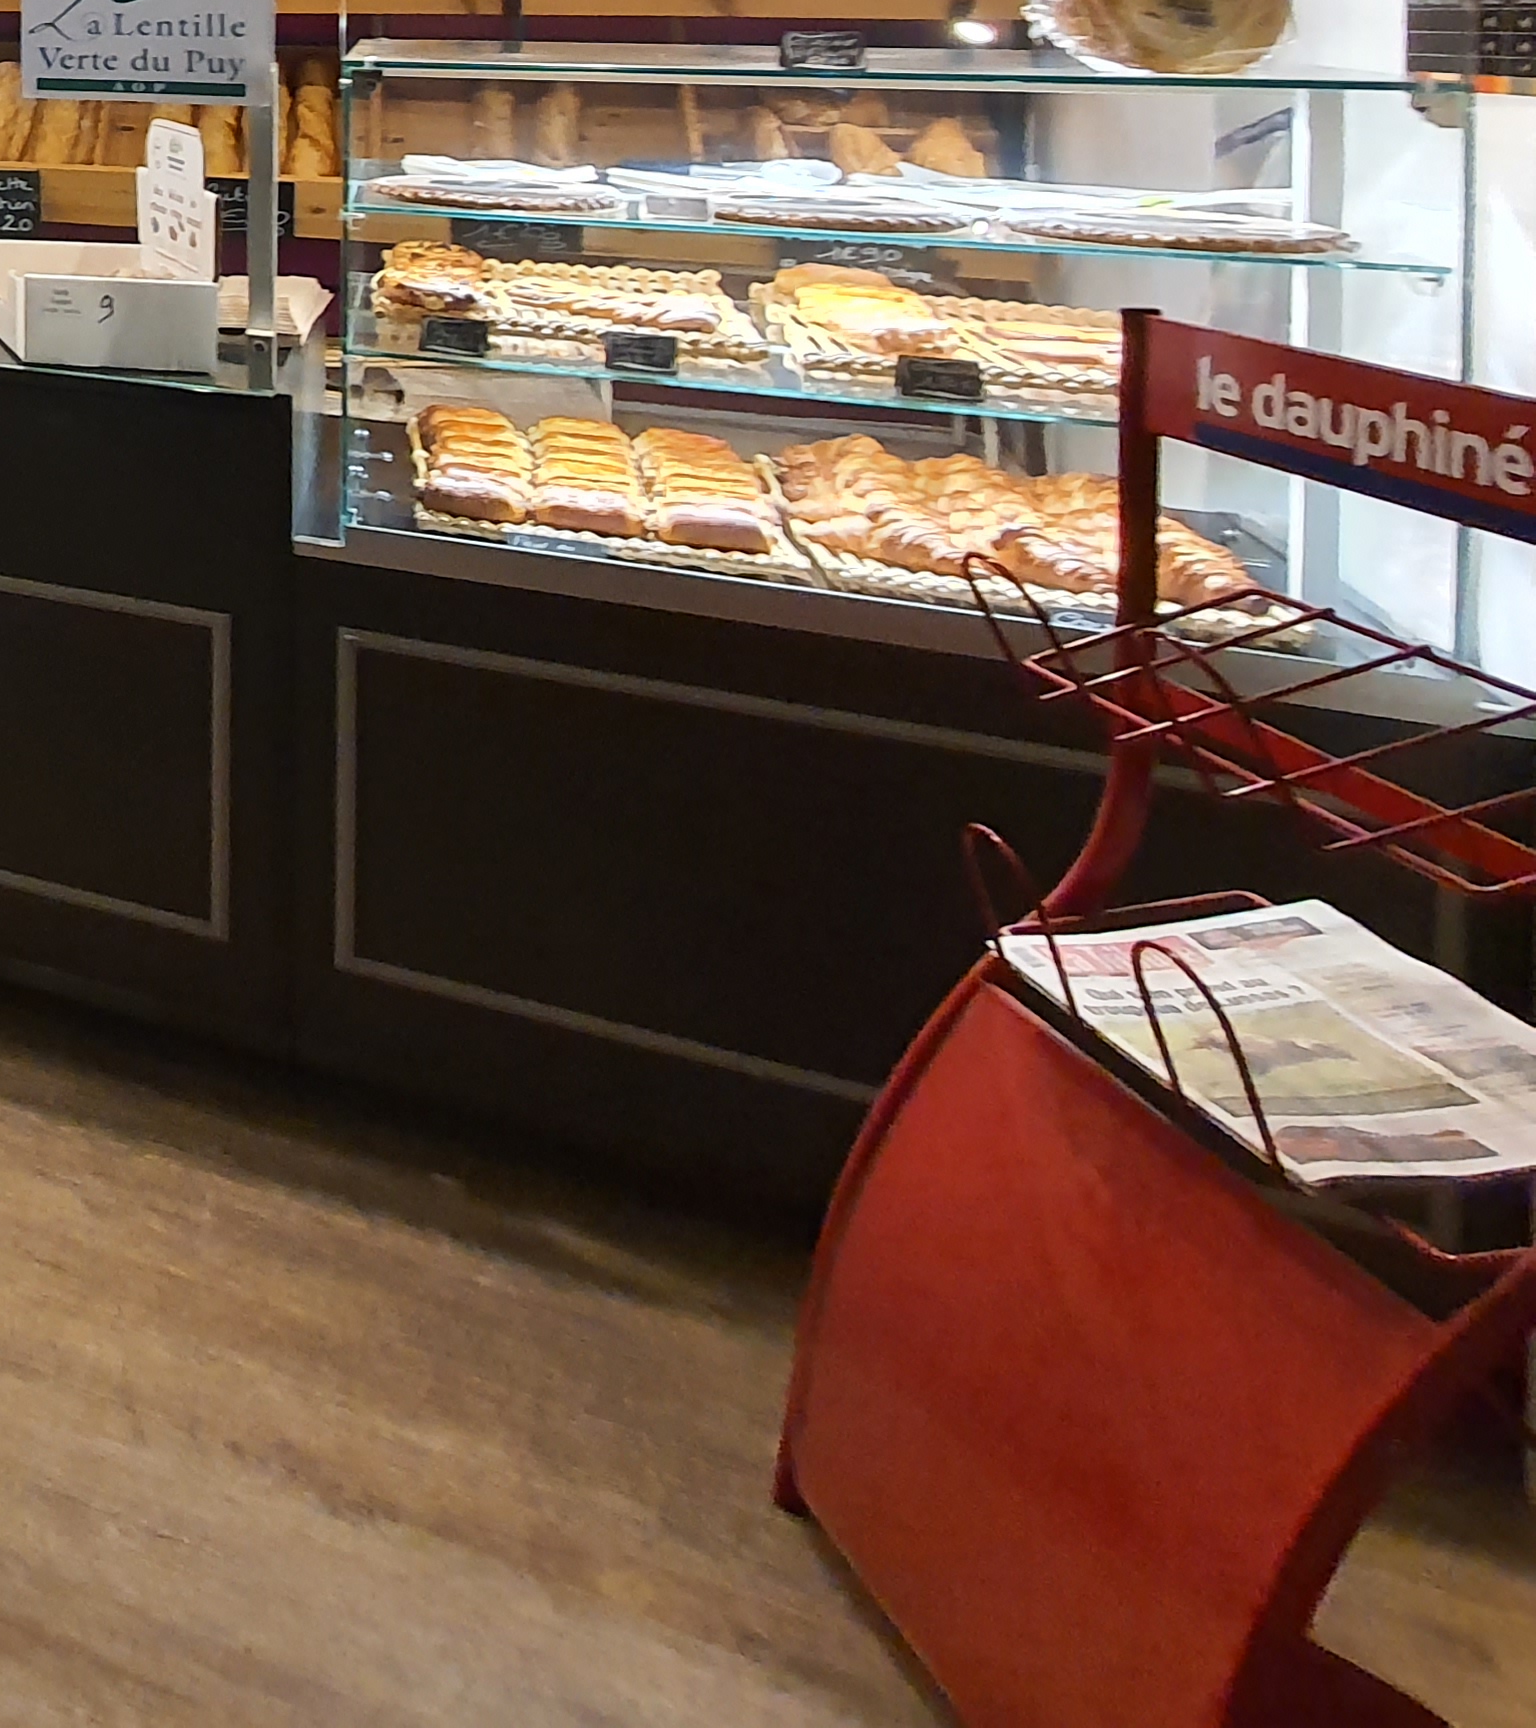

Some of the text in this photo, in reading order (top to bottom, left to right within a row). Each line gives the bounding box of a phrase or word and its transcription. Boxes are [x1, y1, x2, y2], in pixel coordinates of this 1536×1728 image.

[113, 13, 247, 37] Lentille
[38, 46, 247, 81] Verte du Puy
[1196, 355, 1534, 496] le dauphiné
